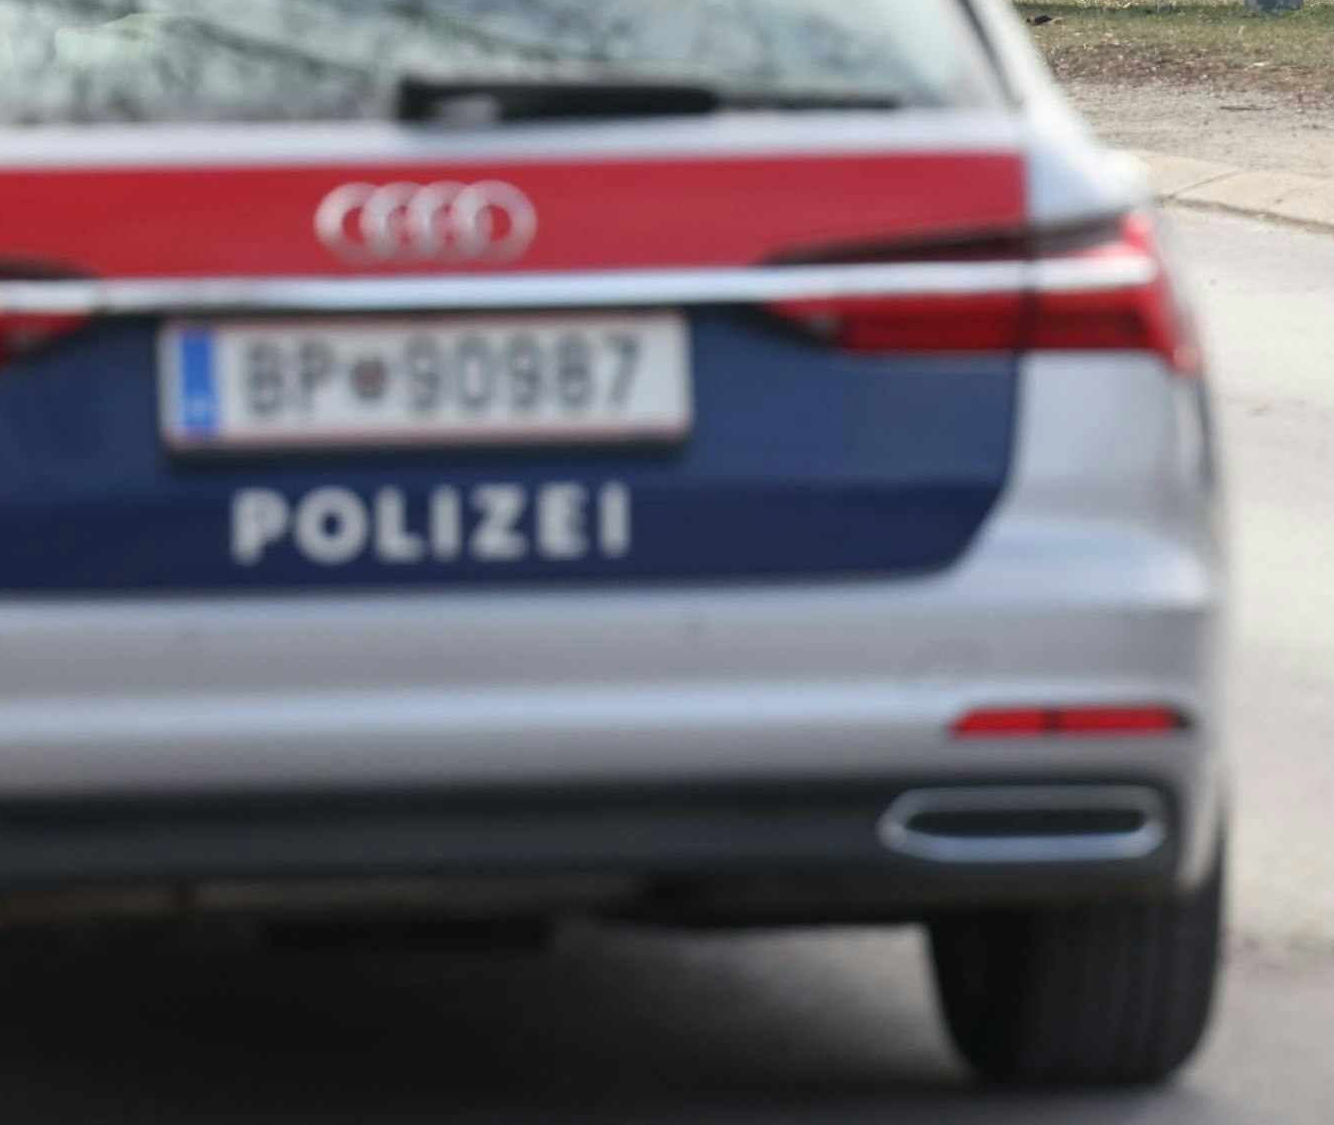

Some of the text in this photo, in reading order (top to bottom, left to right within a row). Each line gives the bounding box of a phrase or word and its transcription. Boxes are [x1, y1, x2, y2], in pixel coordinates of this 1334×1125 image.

[246, 333, 642, 416] BP 90987
[231, 481, 631, 565] POLIZEI
